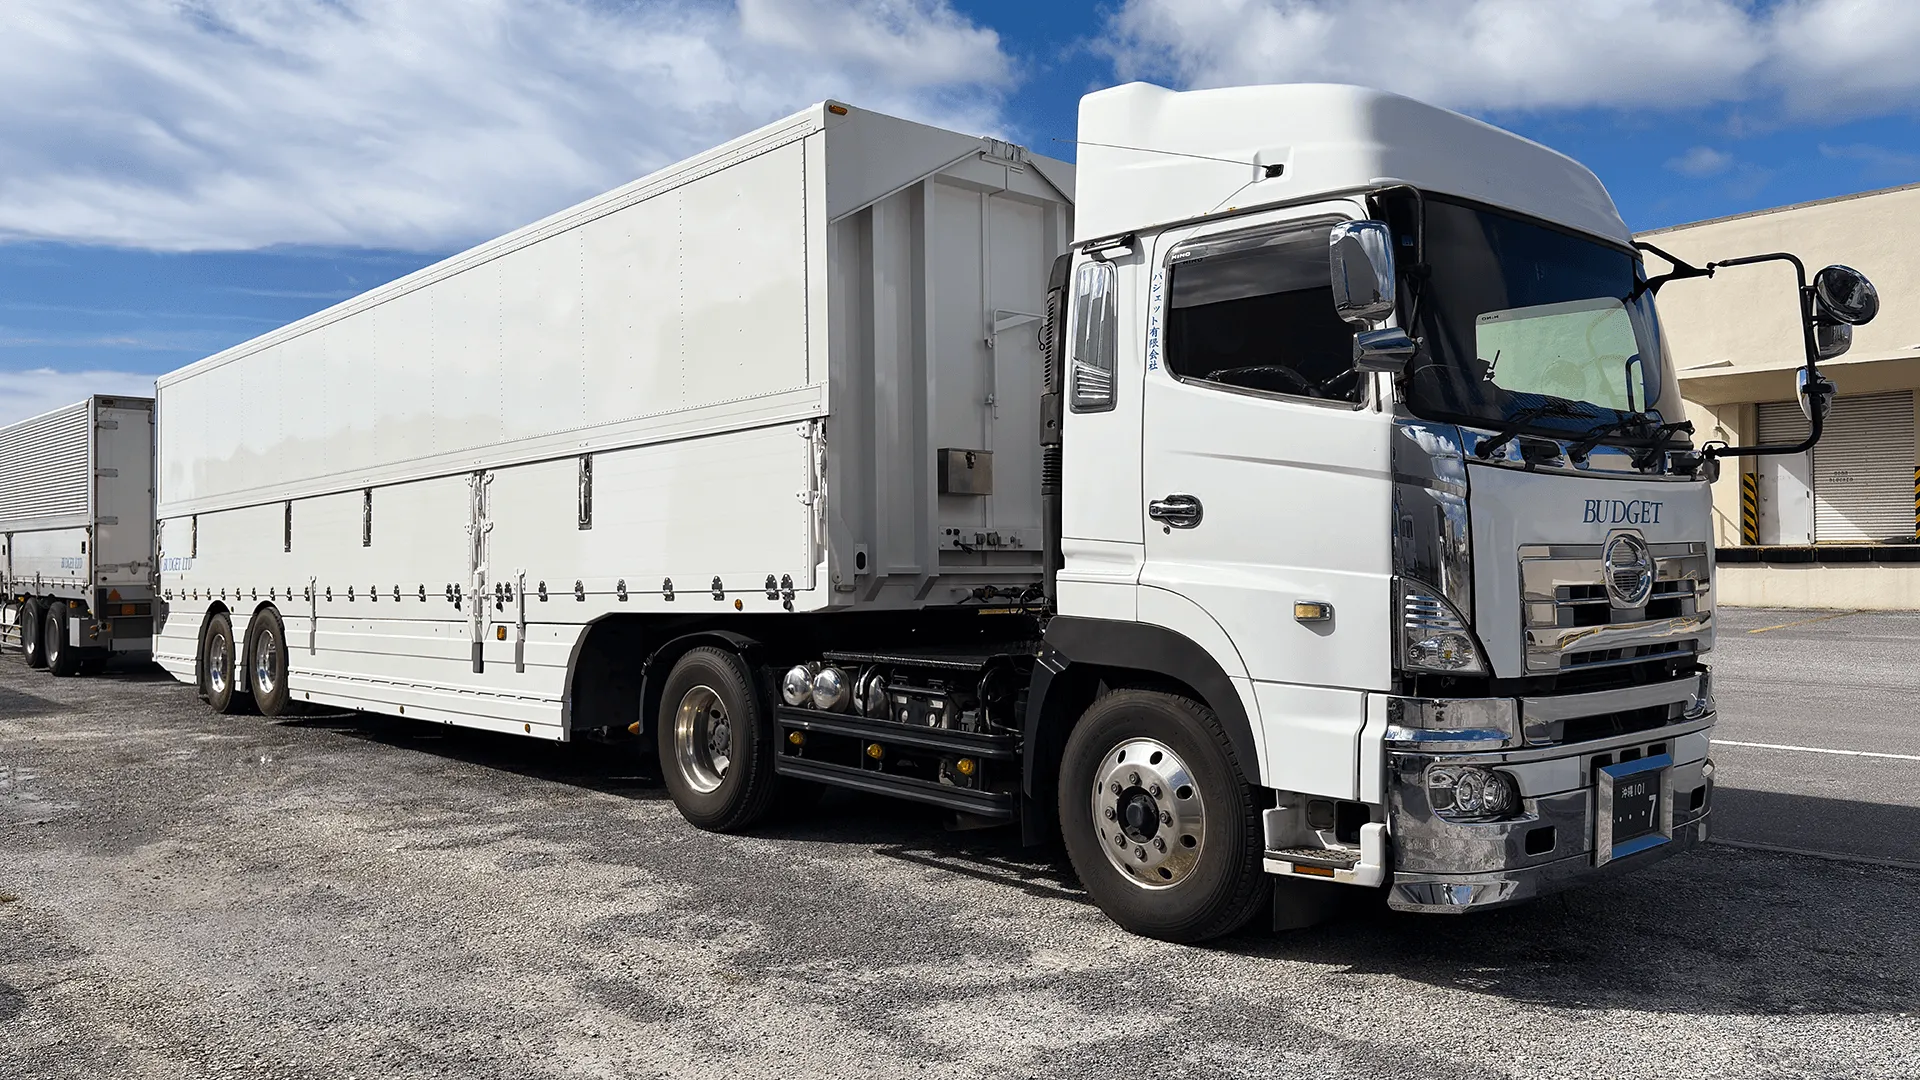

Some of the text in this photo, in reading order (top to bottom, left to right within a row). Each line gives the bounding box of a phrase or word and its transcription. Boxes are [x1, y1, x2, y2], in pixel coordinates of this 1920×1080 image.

[1171, 251, 1191, 260] HINO
[1148, 272, 1163, 371] バジェット有限会社
[1583, 499, 1664, 524] BUDGET
